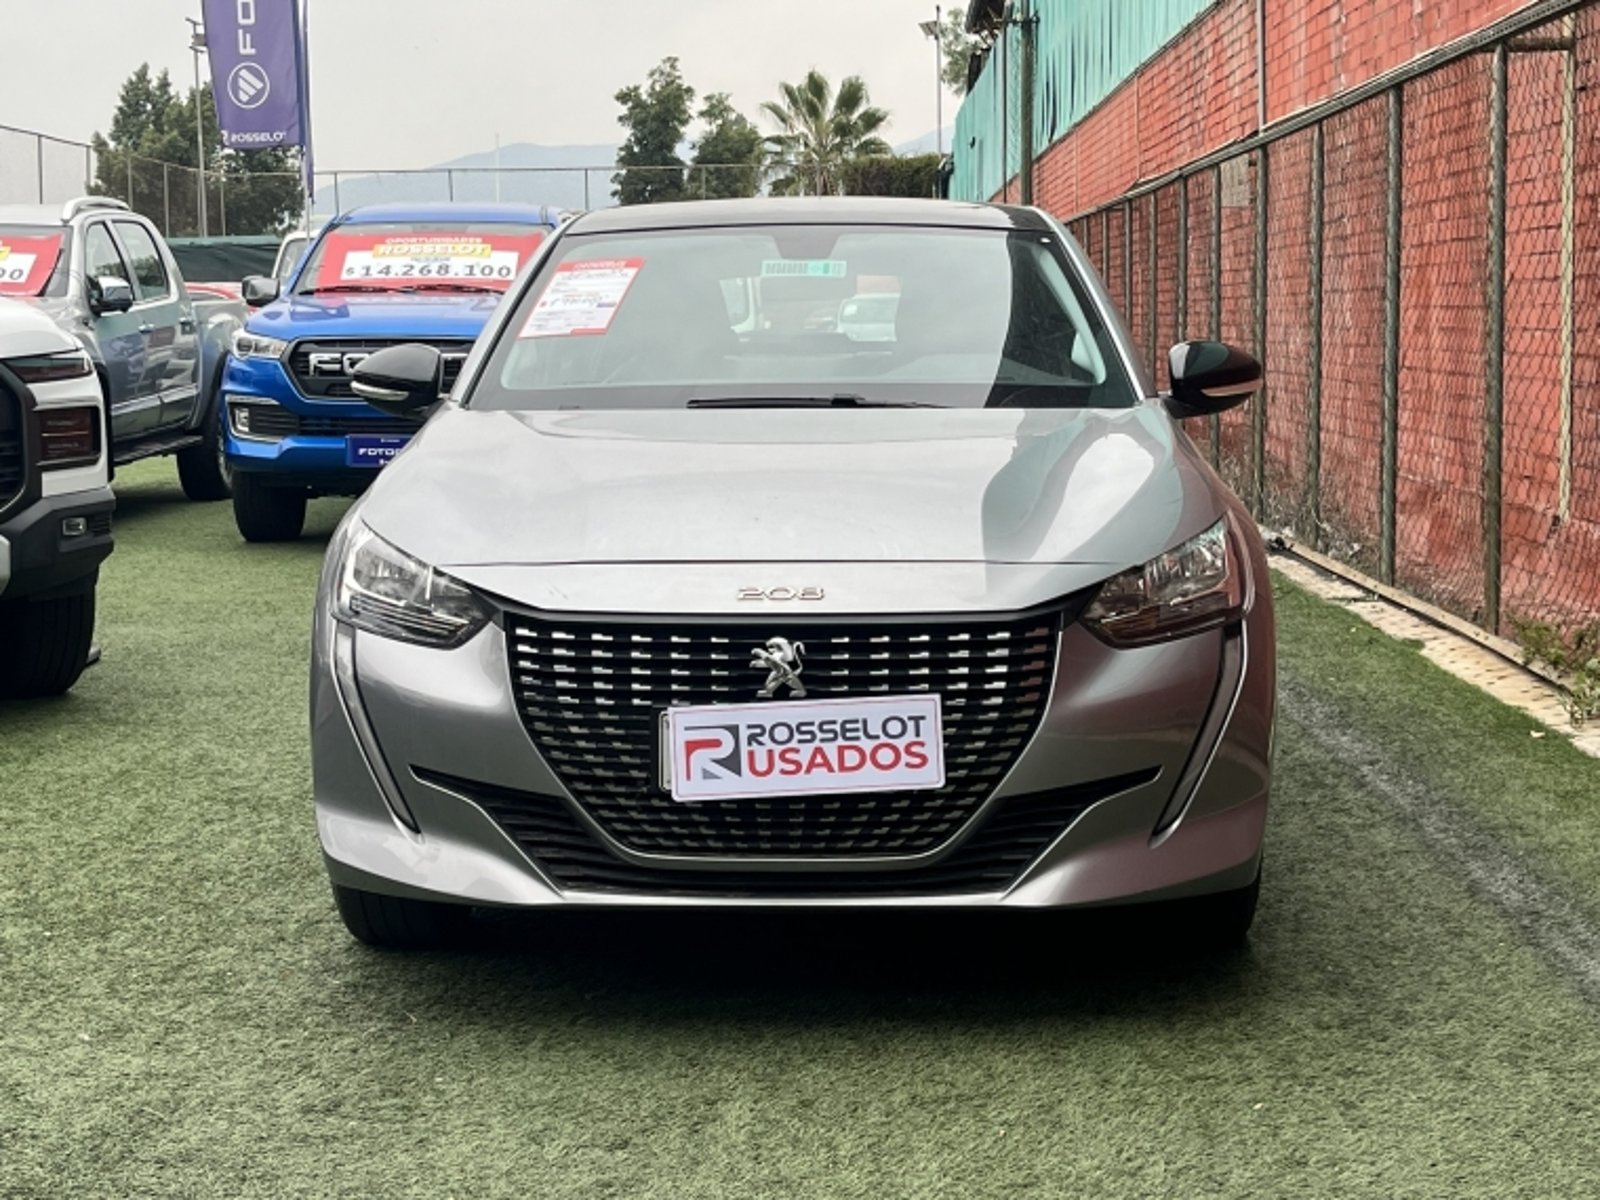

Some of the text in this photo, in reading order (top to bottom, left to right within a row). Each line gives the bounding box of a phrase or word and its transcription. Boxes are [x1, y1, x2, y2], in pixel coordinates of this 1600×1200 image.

[737, 586, 825, 600] 208
[746, 715, 927, 746] ROSSELOT
[747, 740, 929, 778] USADOS
